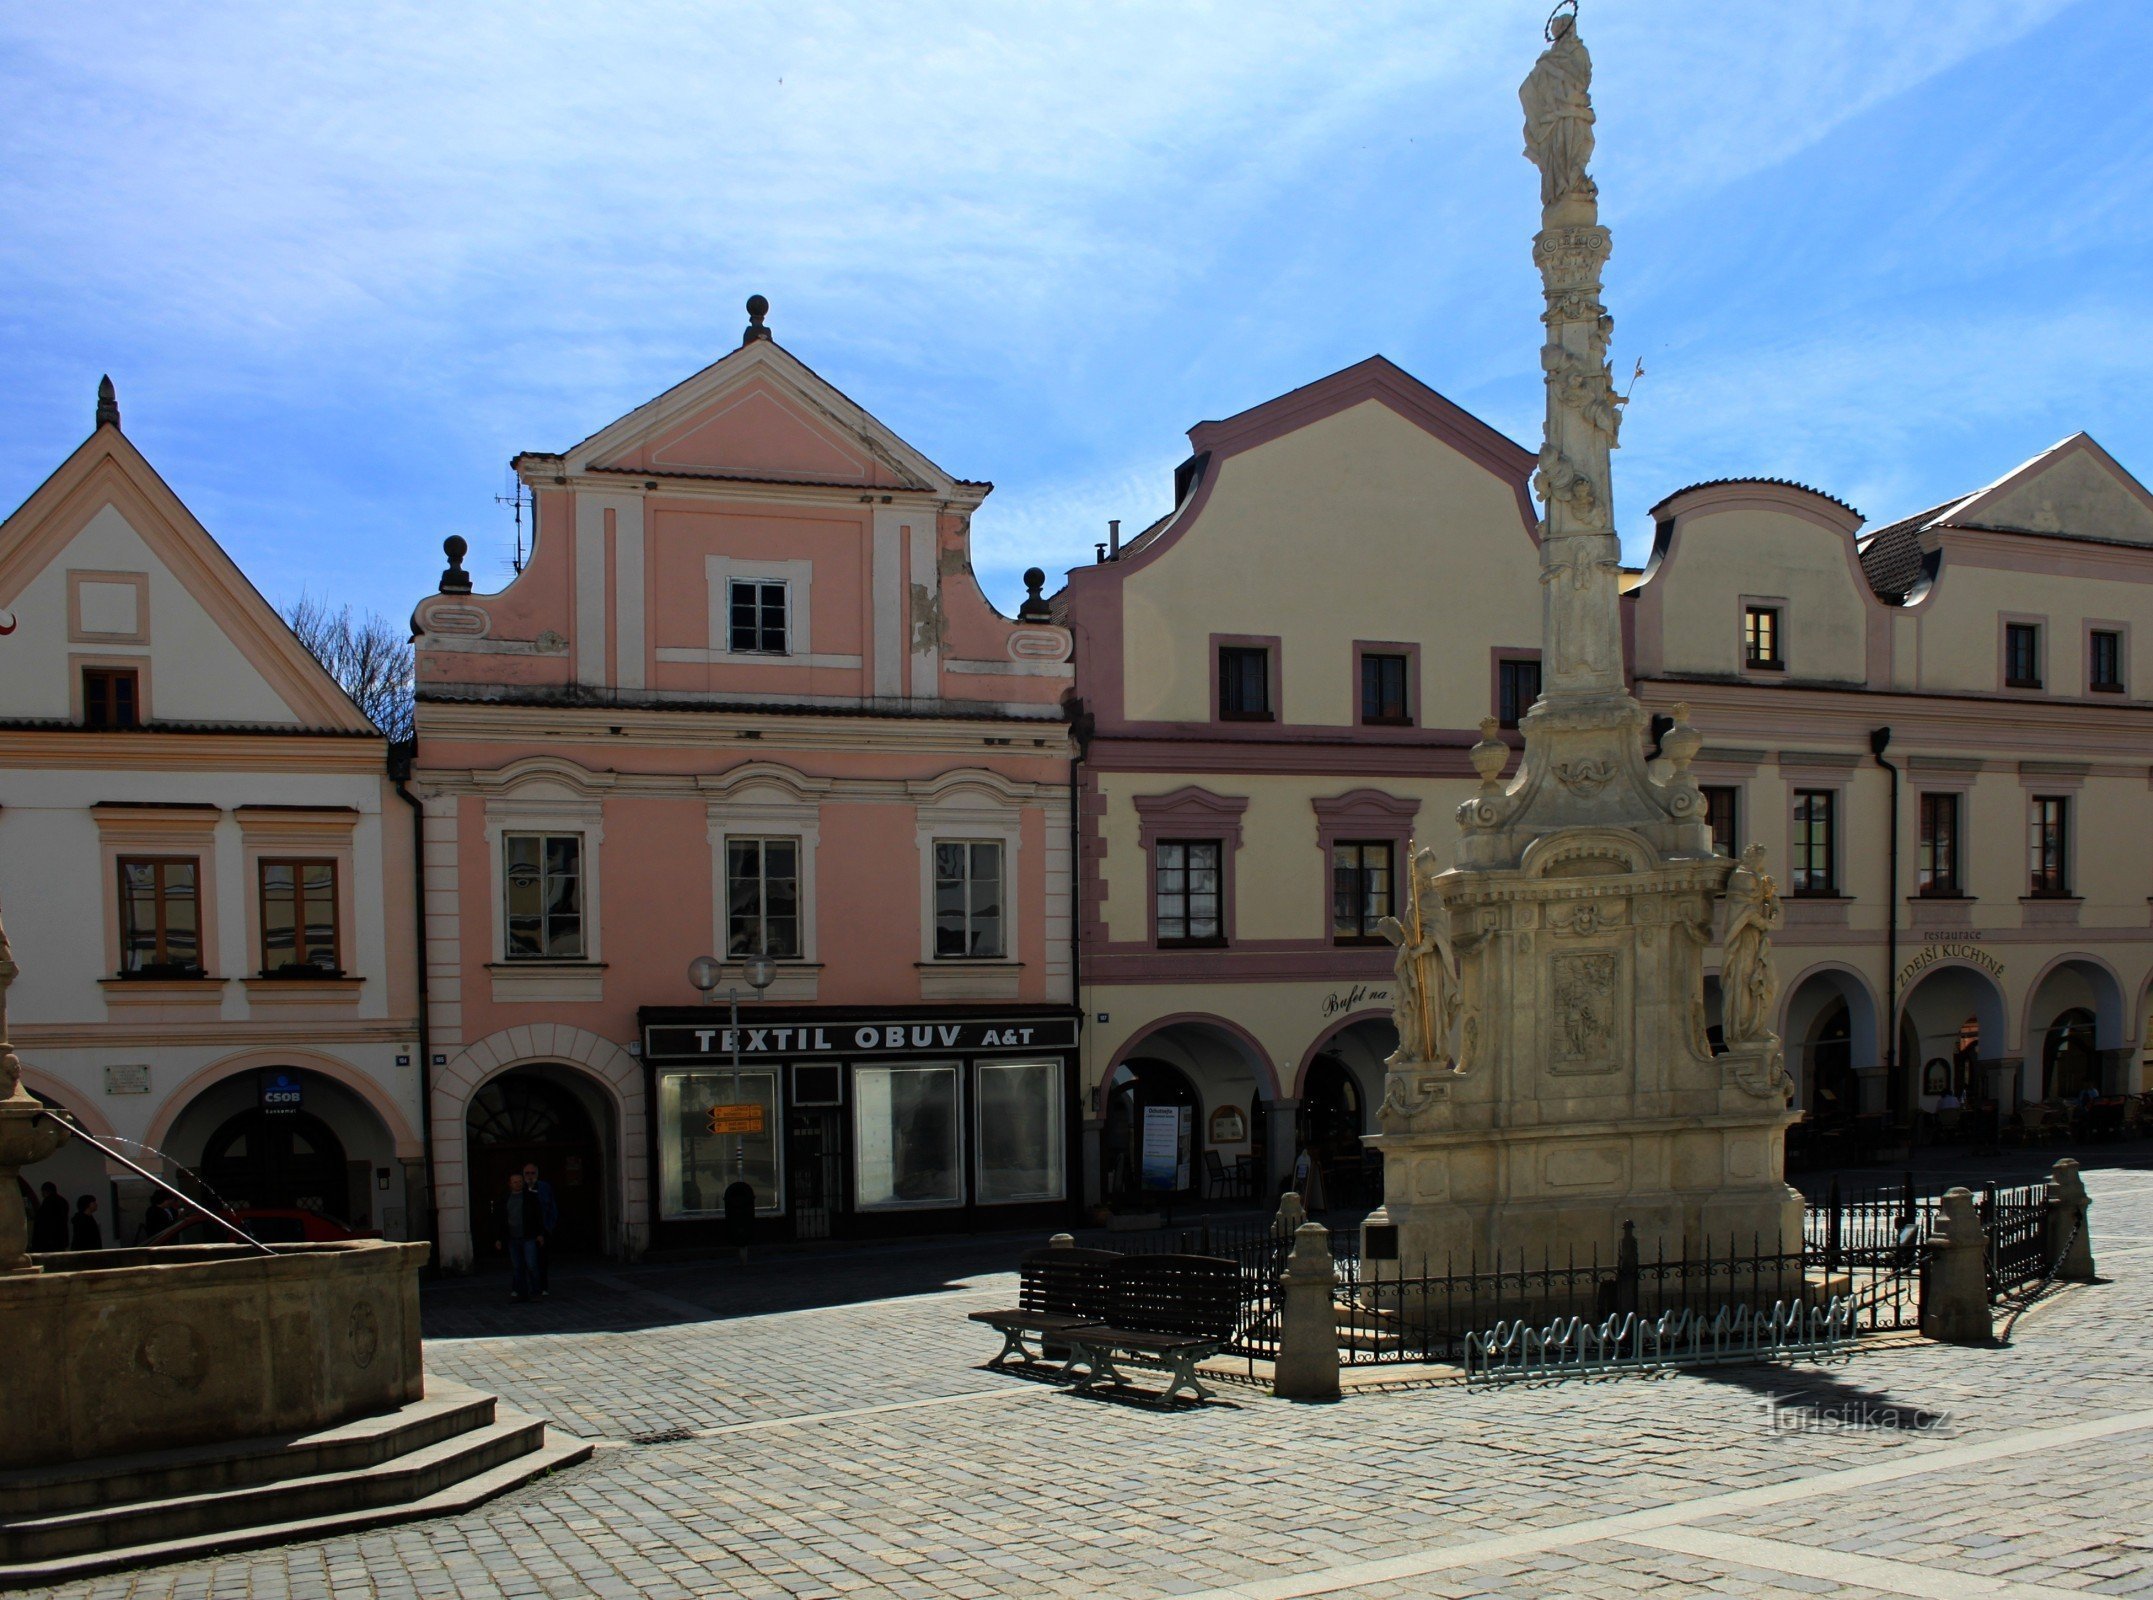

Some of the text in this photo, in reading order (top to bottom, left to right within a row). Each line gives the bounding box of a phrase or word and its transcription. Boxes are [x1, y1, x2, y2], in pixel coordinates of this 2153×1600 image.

[1924, 930, 1982, 940] restaurace
[1897, 944, 2005, 988] ZDEJŠÍ KUCHYNĚ
[1322, 984, 1367, 1017] Bufet
[1369, 991, 1388, 1000] na
[694, 1025, 1034, 1053] TEXTIL OBUV A&T
